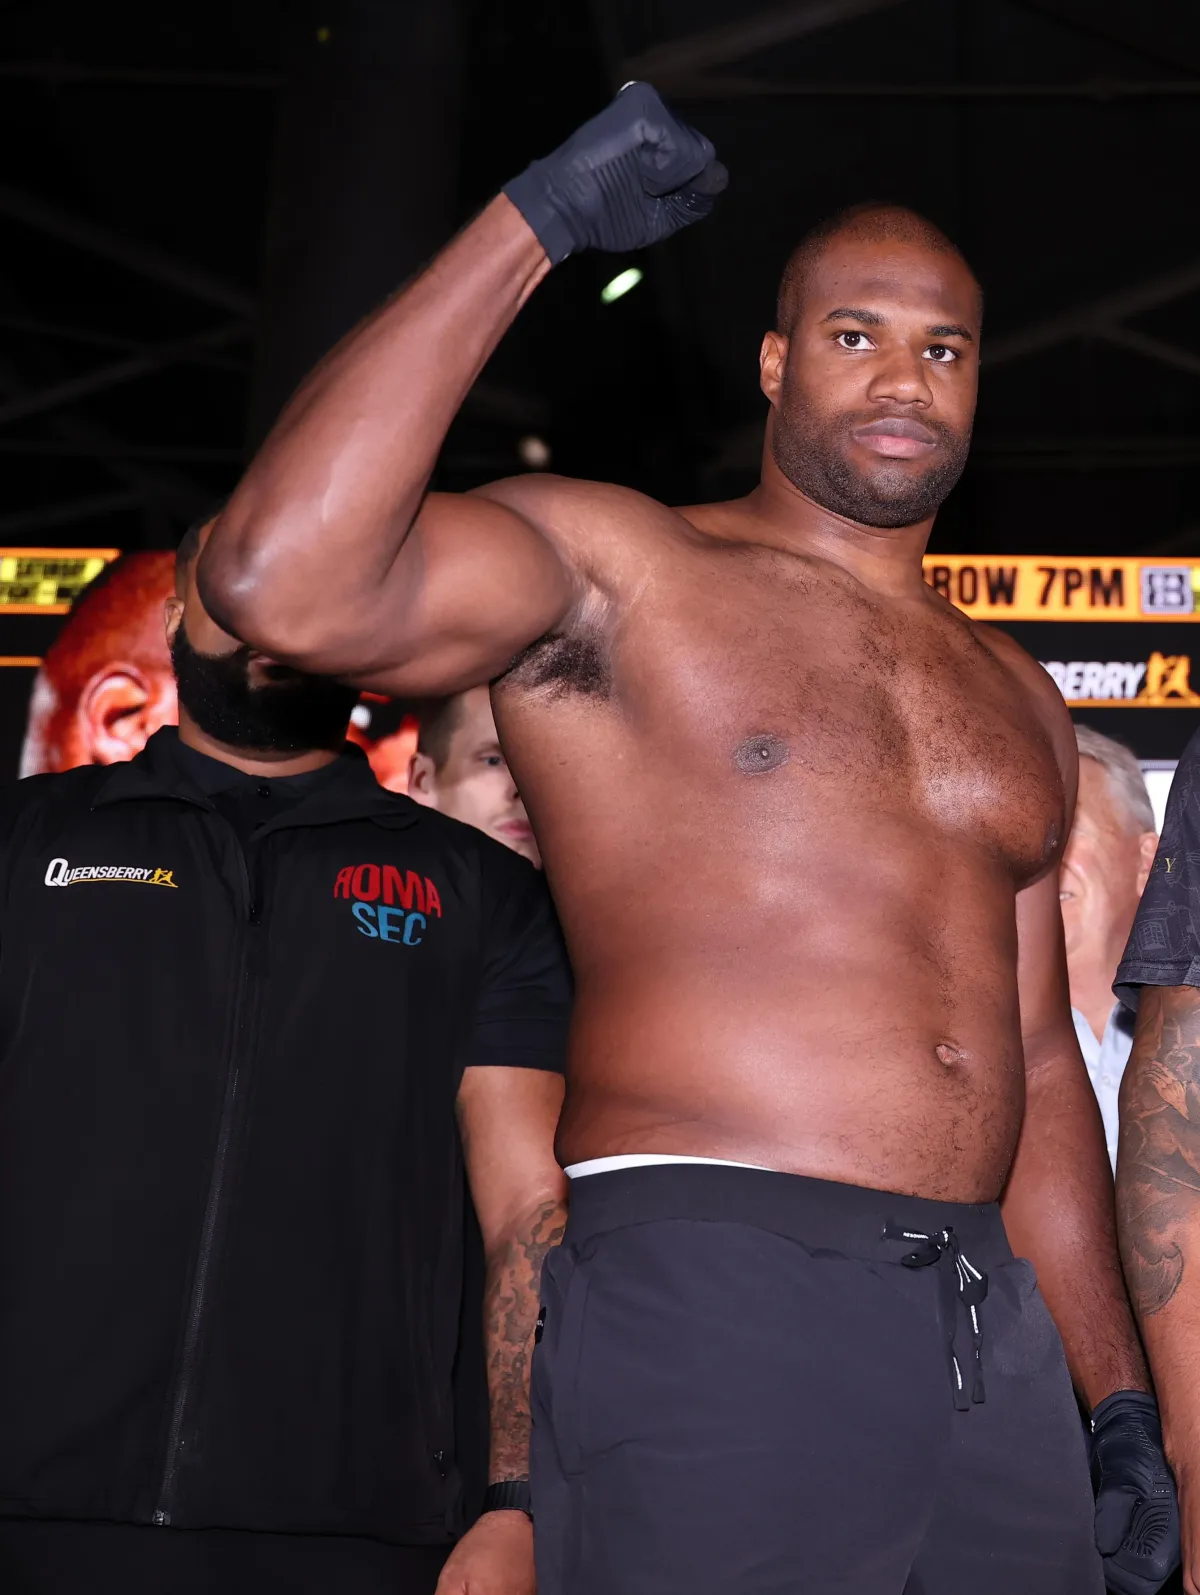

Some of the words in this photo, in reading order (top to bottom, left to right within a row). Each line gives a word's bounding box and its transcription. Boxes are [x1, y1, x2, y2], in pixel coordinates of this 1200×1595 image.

[1036, 567, 1124, 607] 7PM
[1038, 660, 1147, 699] BERRY
[351, 901, 427, 946] SEC
